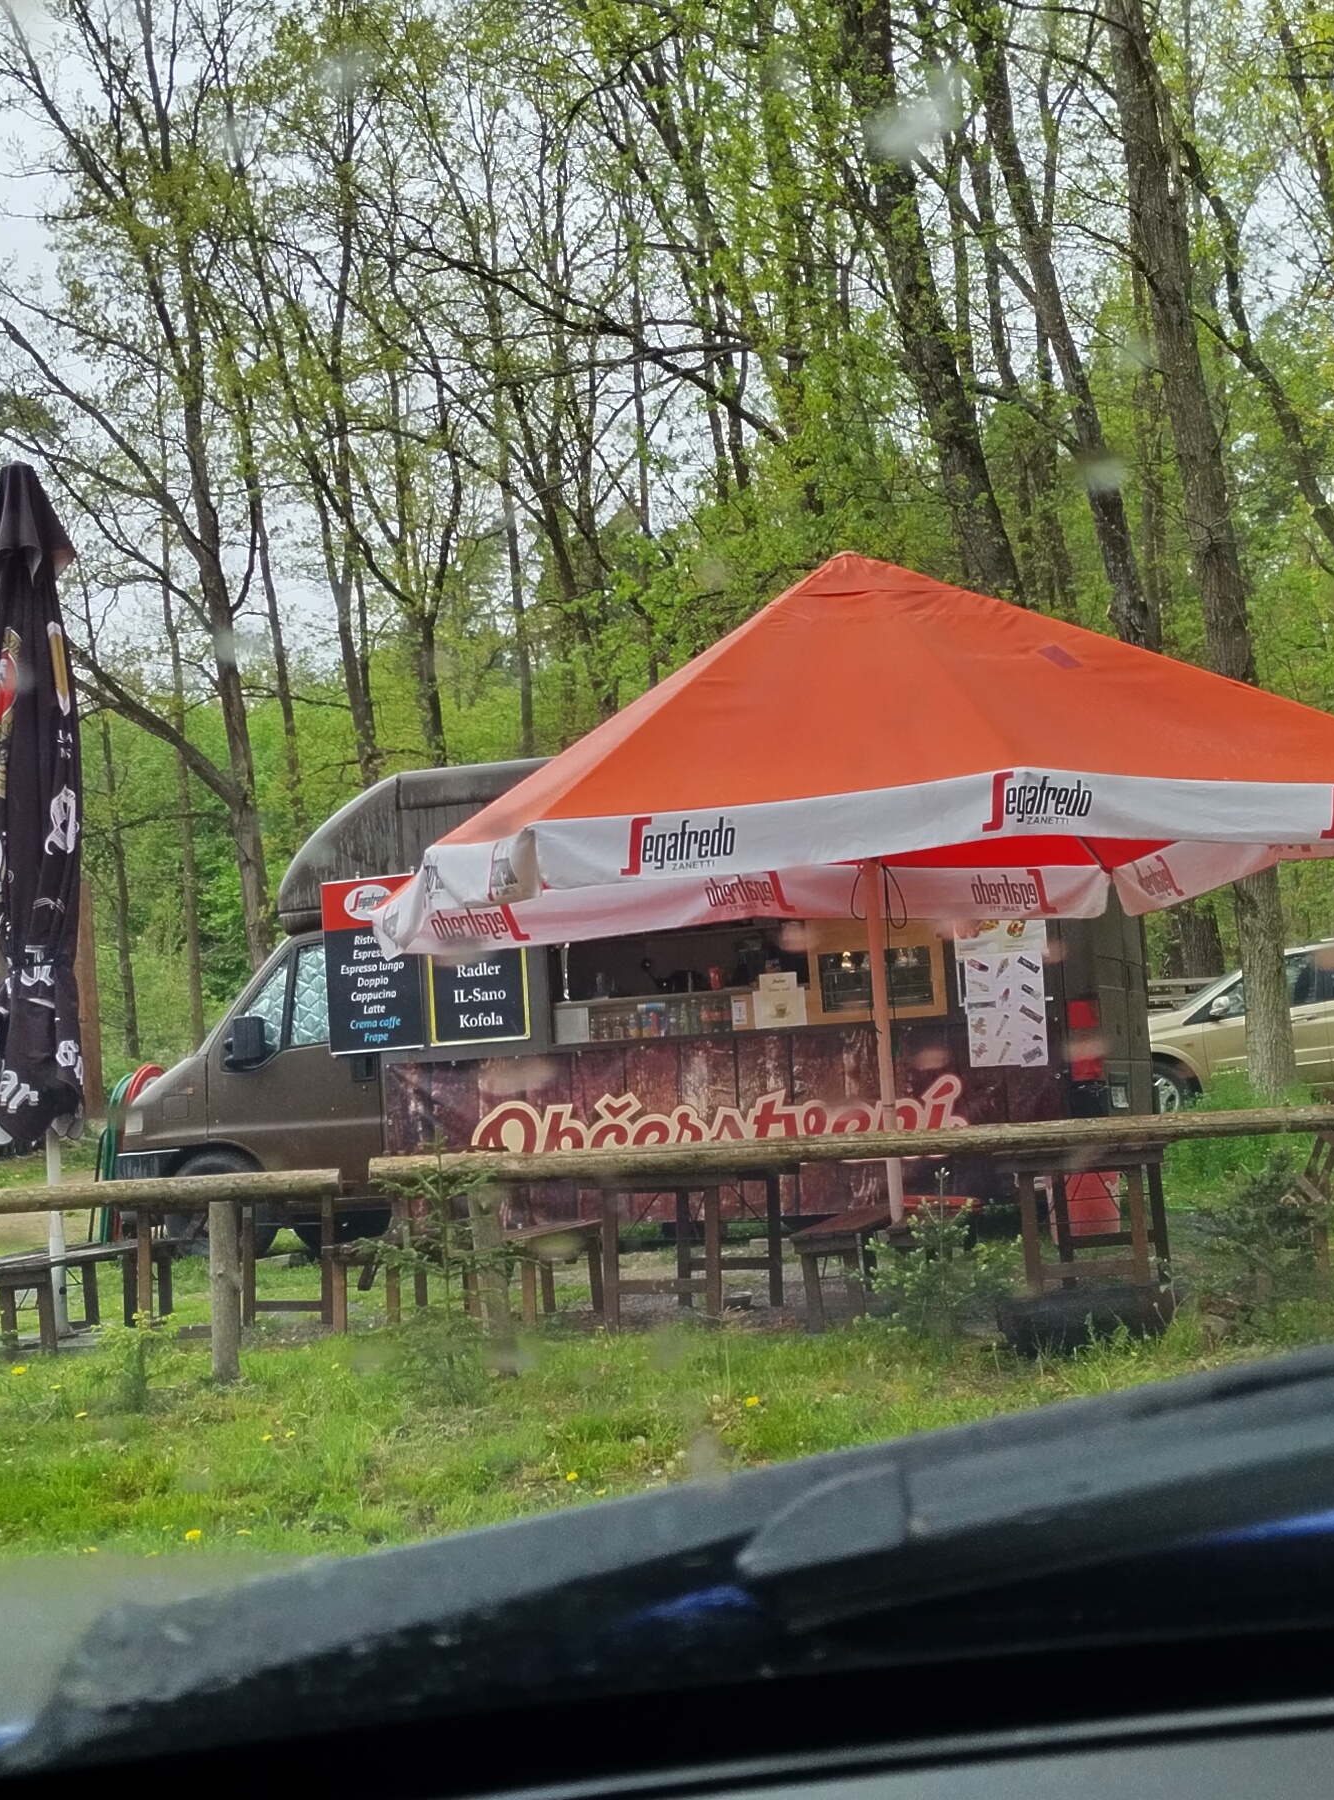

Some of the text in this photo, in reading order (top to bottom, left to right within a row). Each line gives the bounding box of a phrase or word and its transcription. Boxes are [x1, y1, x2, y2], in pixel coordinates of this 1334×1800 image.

[982, 771, 1092, 832] Segafredo
[1027, 815, 1069, 825] ZANETTI
[620, 816, 735, 876] Segafredo
[672, 859, 716, 871] ZANETTI
[353, 949, 385, 961] Espress
[340, 961, 405, 976] Espresso lungo
[456, 962, 501, 978] Radler
[357, 975, 389, 988] Doppio
[350, 989, 397, 1003] Cappucino
[453, 987, 507, 1003] IL-Sano
[363, 1004, 386, 1015] Latte
[350, 1015, 402, 1030] Crema caffe
[459, 1012, 504, 1028] Kofola
[364, 1032, 389, 1044] Frape
